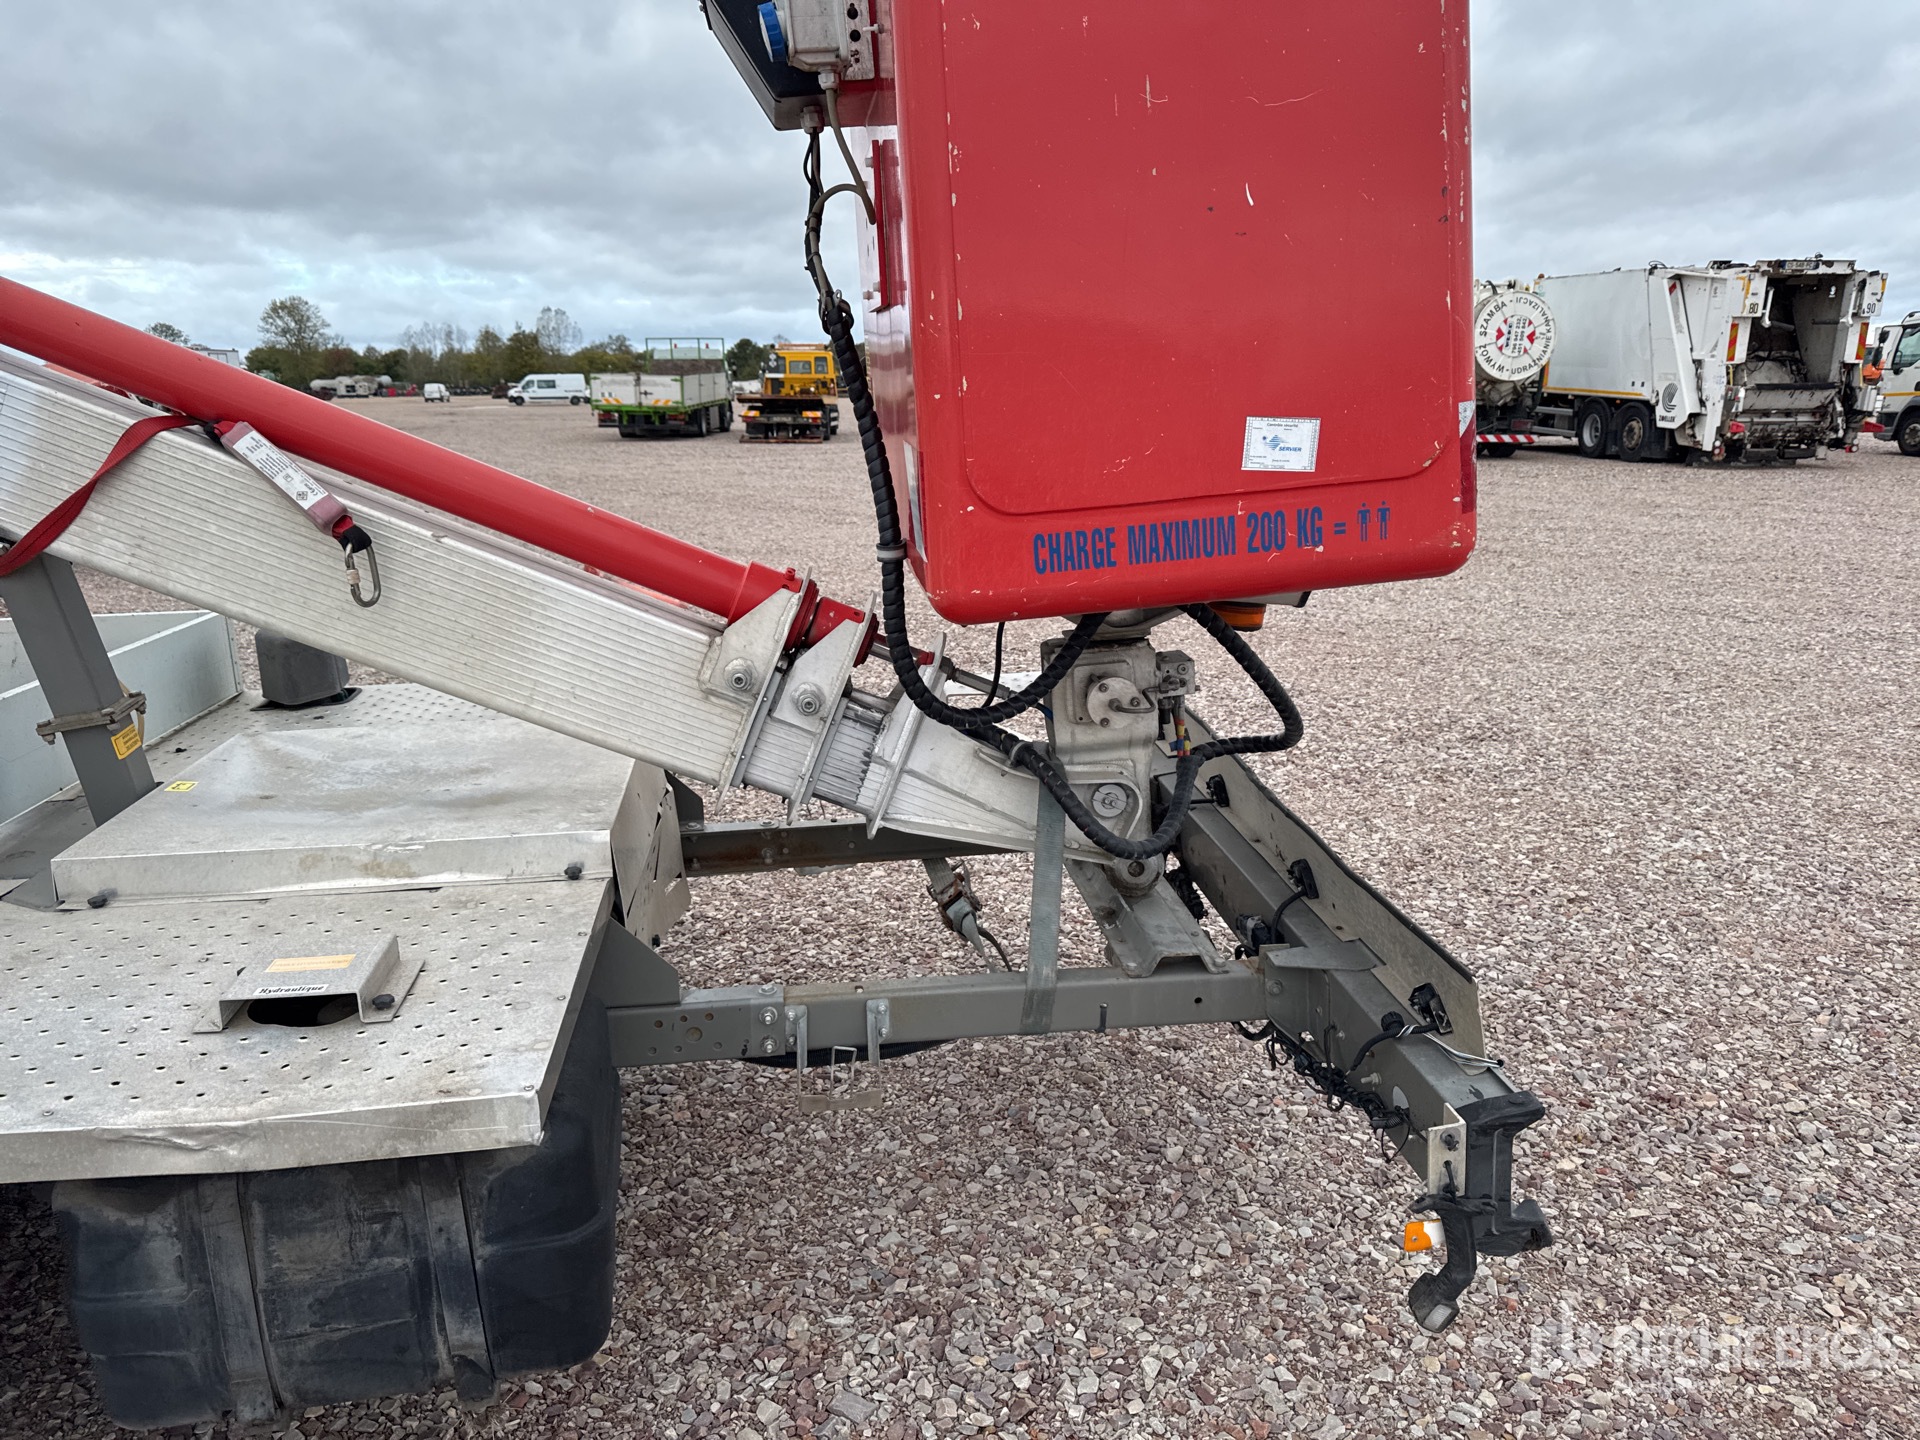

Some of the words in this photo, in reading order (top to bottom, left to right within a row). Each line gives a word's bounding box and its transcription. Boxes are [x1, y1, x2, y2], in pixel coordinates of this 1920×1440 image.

[1479, 301, 1507, 337] SZAMBA
[1515, 296, 1552, 333] KANALIZACJI
[1866, 303, 1876, 314] 90
[1033, 527, 1117, 575] CHARGE
[1128, 515, 1236, 565] MAXIMUM
[1247, 510, 1286, 553] 200
[1297, 506, 1323, 548] KG
[259, 985, 324, 994] Hydraulique
